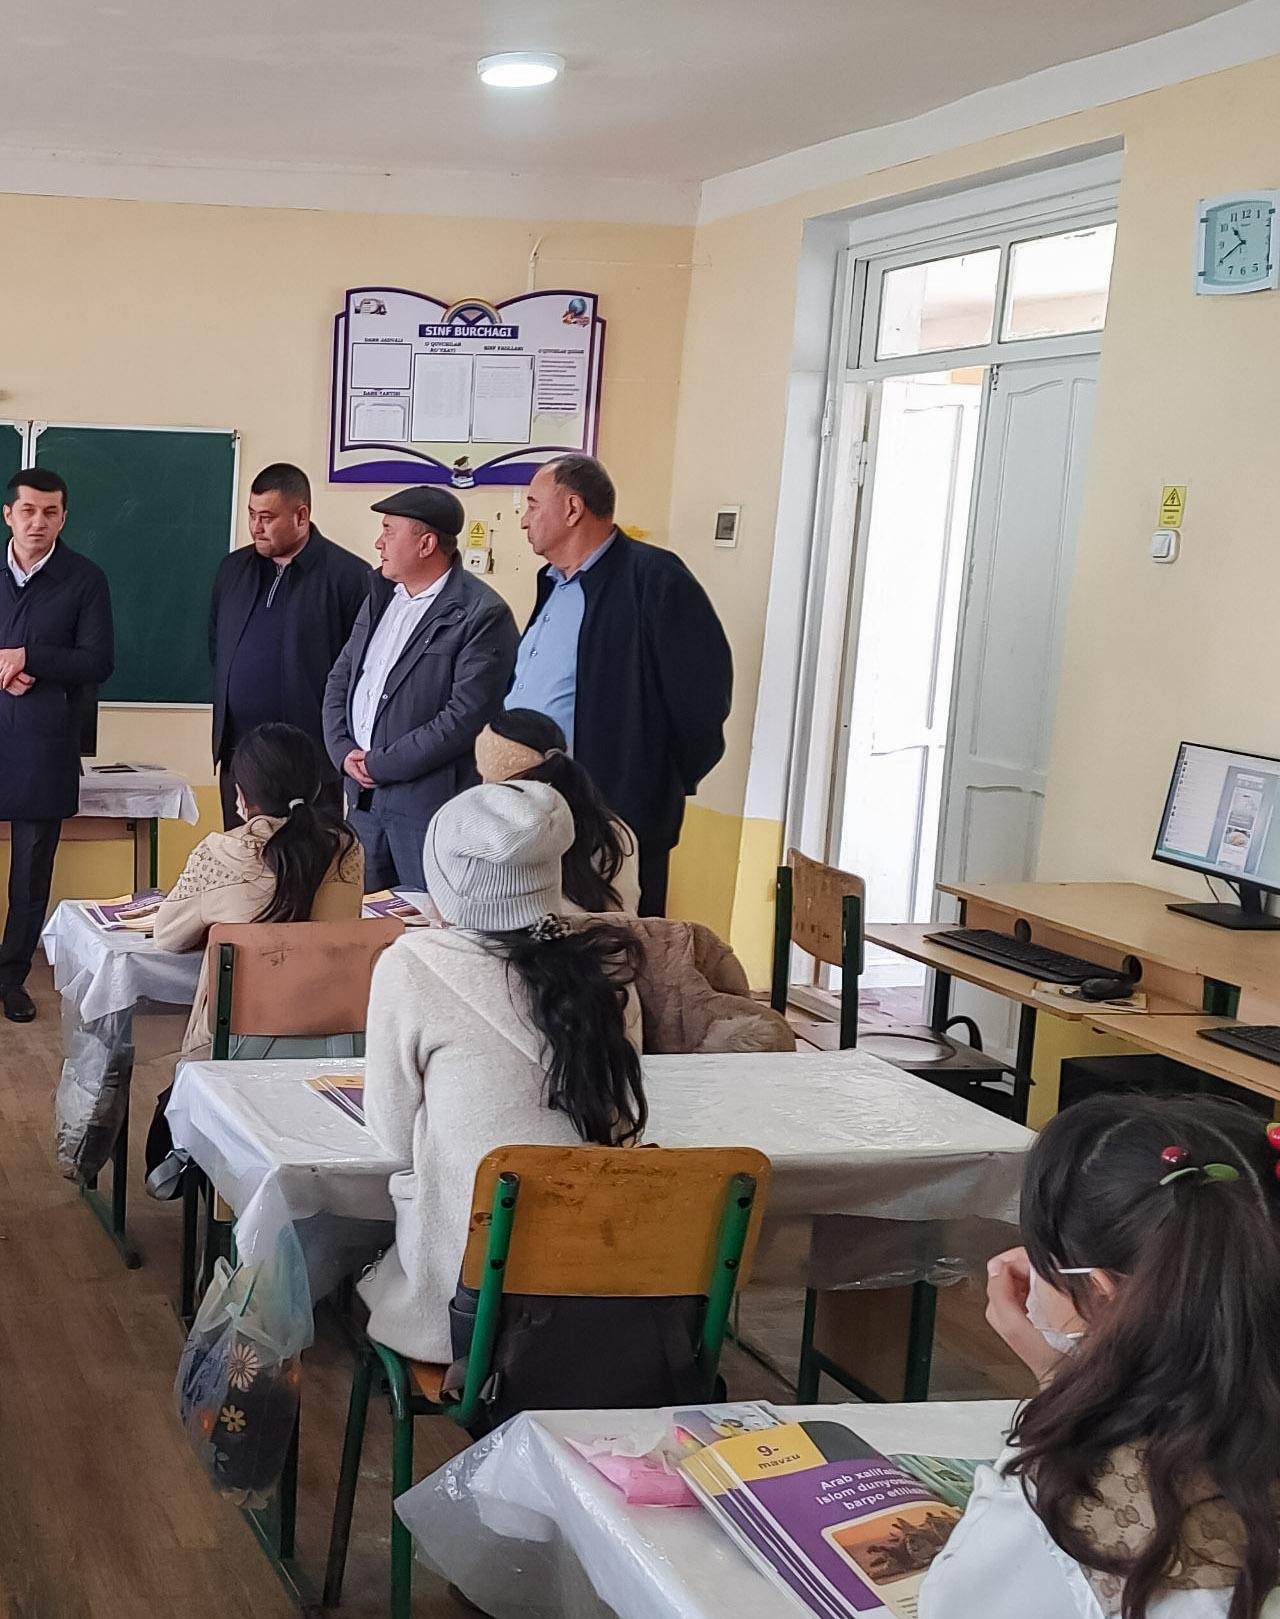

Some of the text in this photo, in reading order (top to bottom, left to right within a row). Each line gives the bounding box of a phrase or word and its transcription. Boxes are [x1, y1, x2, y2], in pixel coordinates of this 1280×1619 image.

[1230, 212, 1238, 222] 11
[1242, 209, 1251, 219] 12
[1256, 210, 1260, 219] 1
[425, 326, 512, 337] SINF BURCHAGI
[757, 1445, 780, 1457] 9-
[758, 1453, 801, 1470] mavzu
[820, 1474, 853, 1491] Arab
[816, 1486, 856, 1505] Islom
[843, 1492, 885, 1512] barpo
